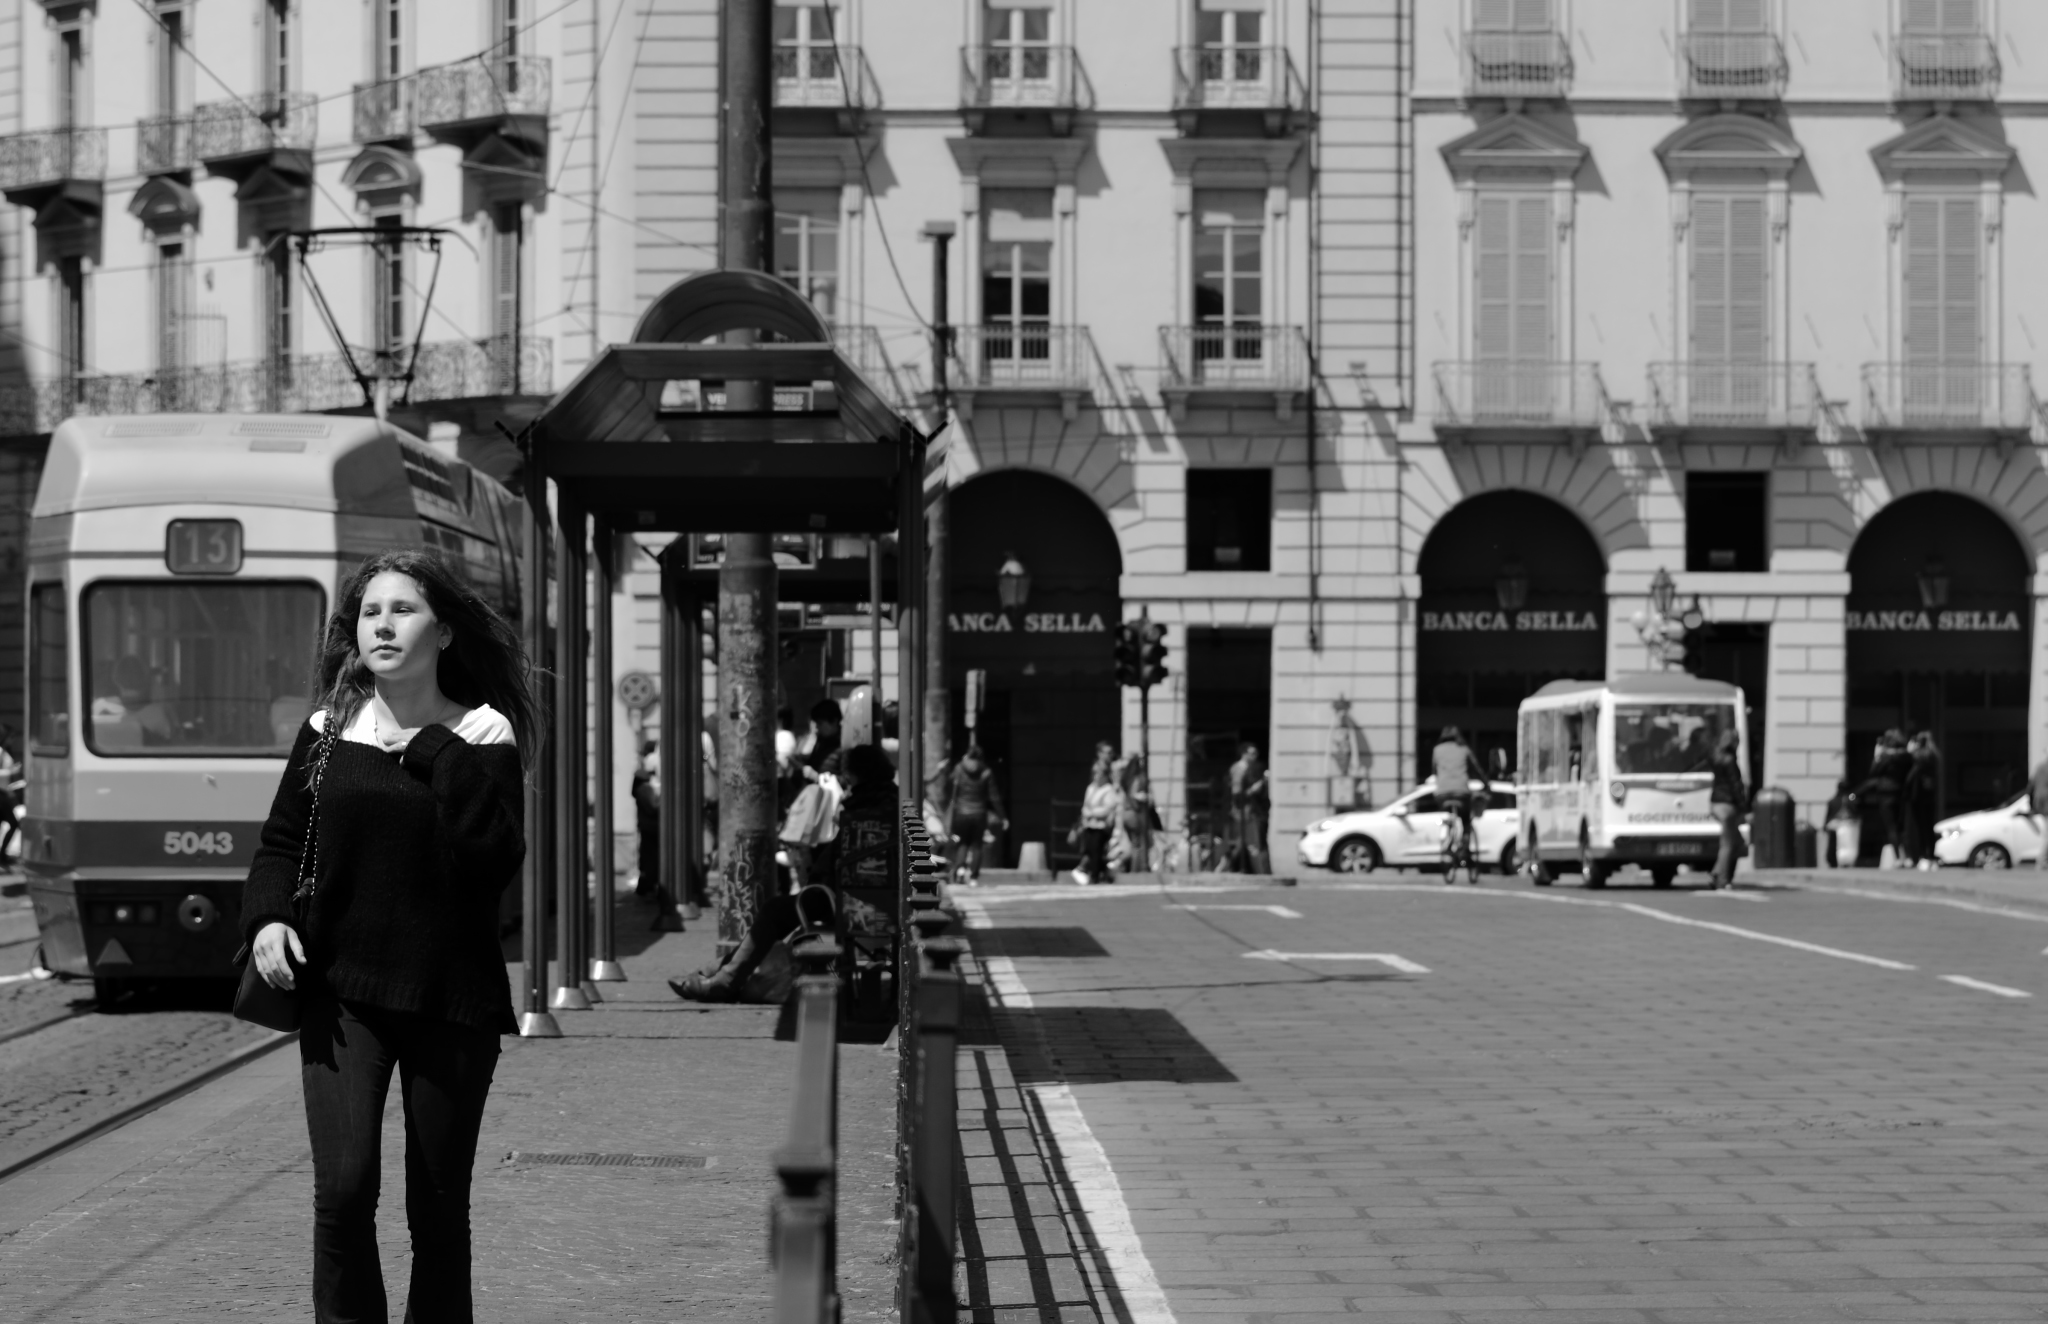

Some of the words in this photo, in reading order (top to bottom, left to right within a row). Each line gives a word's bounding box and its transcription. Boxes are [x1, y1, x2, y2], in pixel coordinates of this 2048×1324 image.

[185, 524, 228, 564] 13
[948, 612, 1012, 632] ANCA
[1025, 612, 1105, 632] SELLA
[1422, 610, 1509, 631] BANCA
[1515, 610, 1598, 631] SELLA
[1846, 610, 1932, 631] BANCA
[1938, 610, 2021, 631] SELLA
[163, 831, 234, 855] 5043
